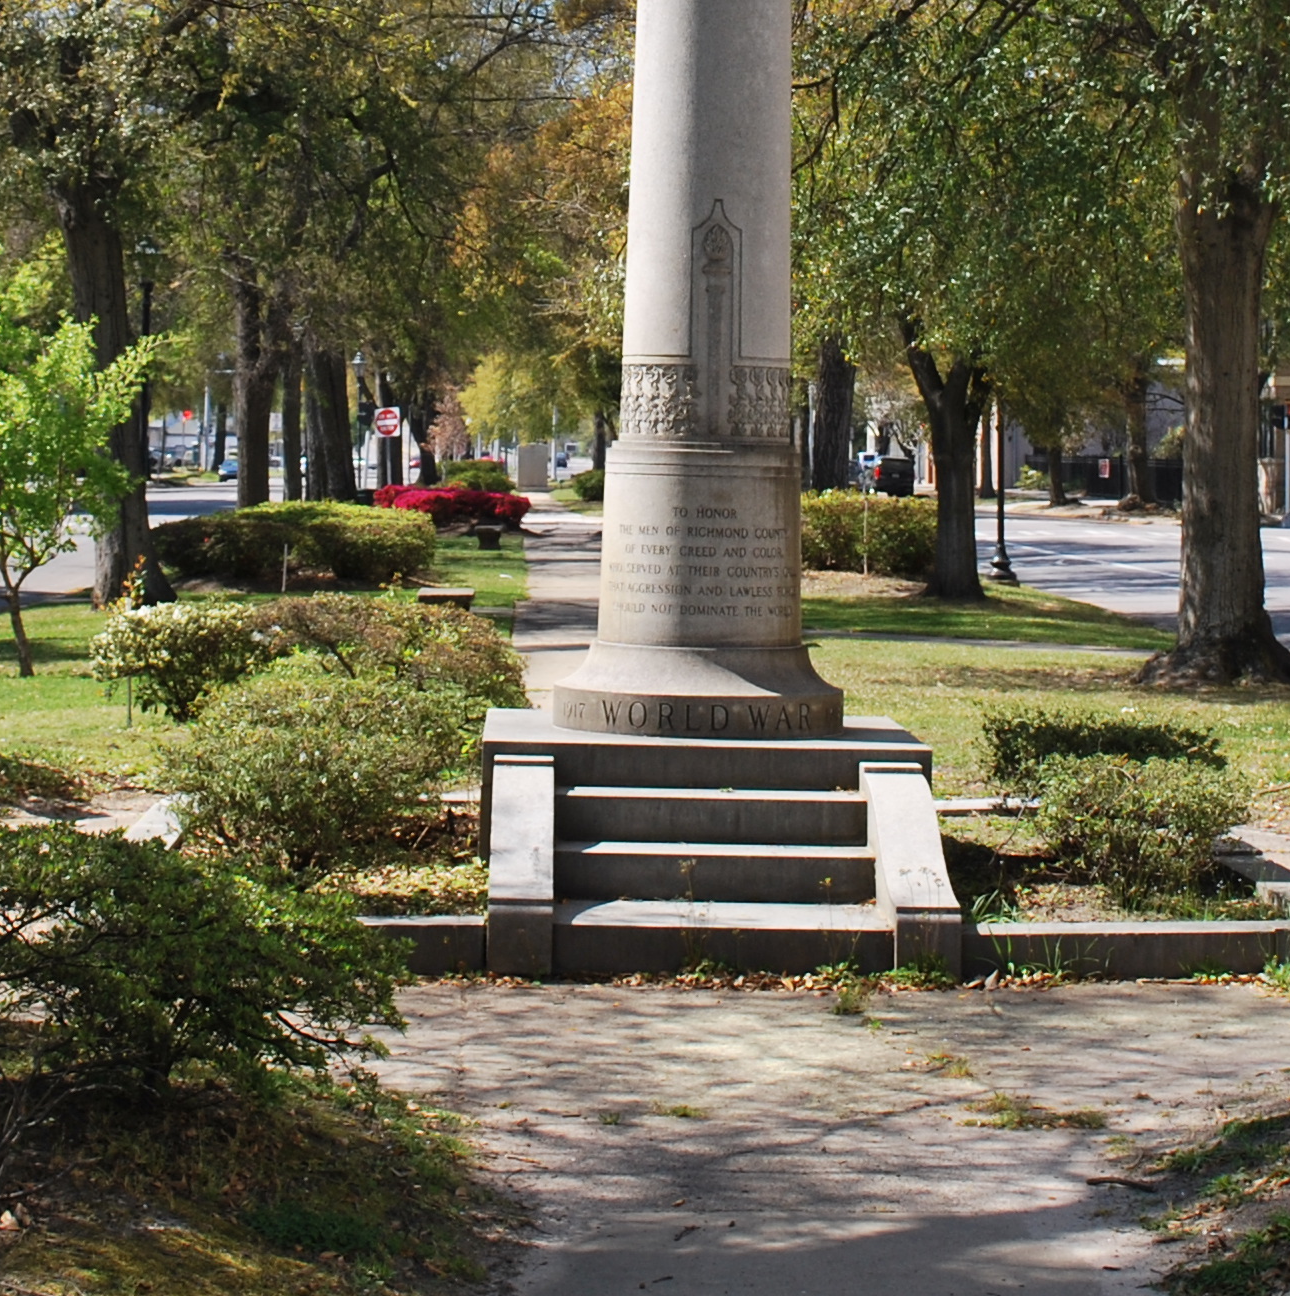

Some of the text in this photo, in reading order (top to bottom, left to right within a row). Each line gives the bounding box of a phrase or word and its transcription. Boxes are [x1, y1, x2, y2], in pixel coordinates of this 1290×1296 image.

[672, 507, 737, 519] TO HONOR
[619, 524, 633, 535] THE
[639, 525, 659, 536] MEN
[666, 526, 681, 536] OF
[688, 527, 749, 539] RICHMOND
[625, 544, 636, 554] OF
[641, 545, 671, 555] EVERY
[679, 546, 716, 557] CREED
[723, 547, 747, 558] AND
[627, 564, 661, 574] SERVED
[667, 565, 681, 576] AT
[688, 566, 720, 577] THEIR
[628, 583, 692, 595] AGGRESSION
[698, 585, 723, 596] AND
[730, 586, 773, 597] LAWLESS
[651, 604, 672, 614] NOT
[680, 605, 738, 616] DOMINATE
[745, 606, 762, 616] THE
[563, 701, 586, 718] 1917
[602, 700, 729, 731] WORLD
[748, 703, 811, 730] WAR
